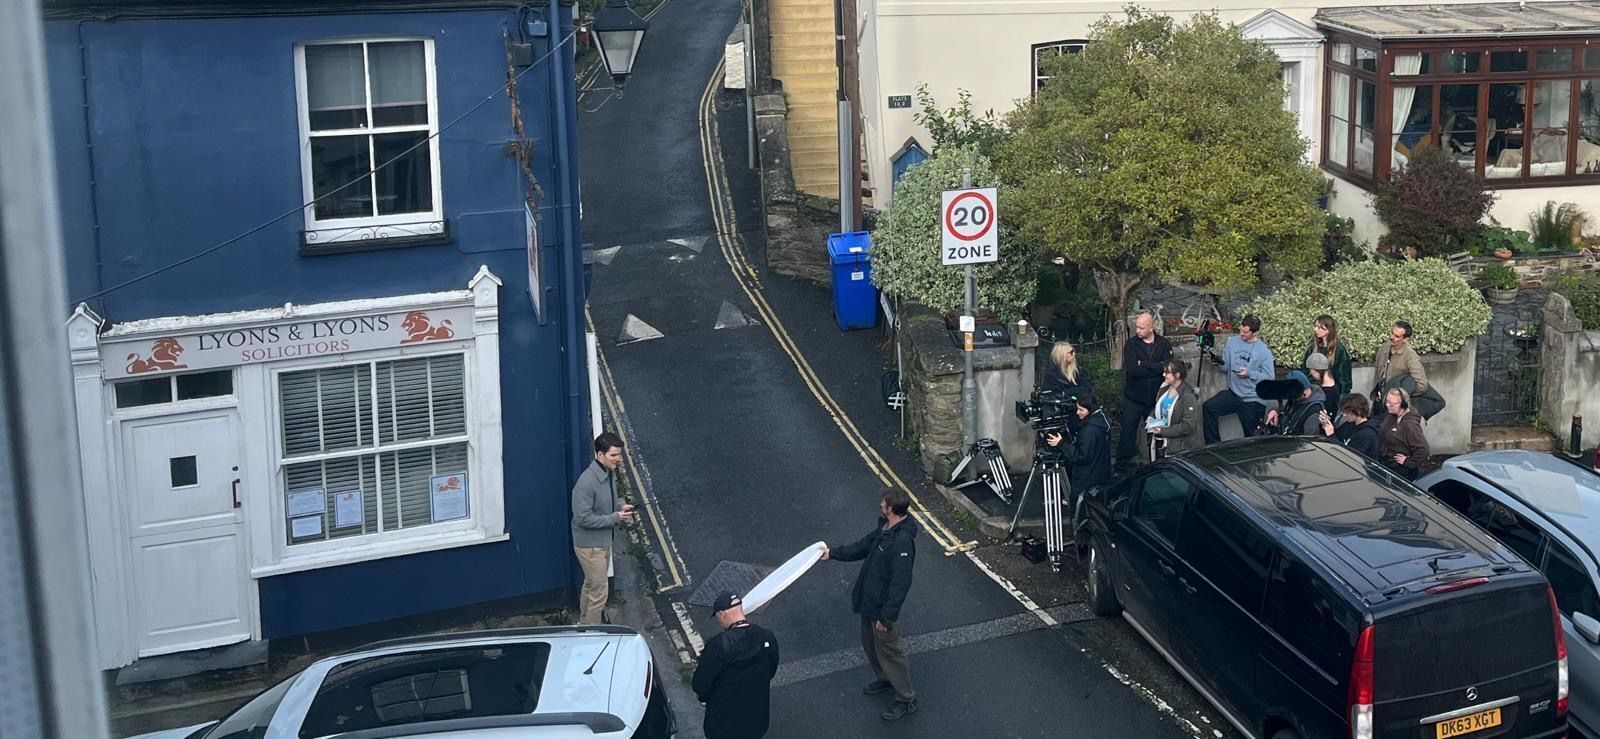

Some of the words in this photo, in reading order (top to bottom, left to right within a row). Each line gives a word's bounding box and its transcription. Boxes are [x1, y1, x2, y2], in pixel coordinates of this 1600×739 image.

[954, 206, 987, 227] 20
[948, 245, 991, 260] ZONE
[198, 327, 280, 351] LYONS
[288, 324, 305, 341] &
[311, 315, 390, 338] LYONS
[241, 339, 350, 362] SOLICITORS
[1441, 717, 1472, 736] DK63
[1474, 711, 1495, 729] XGT
